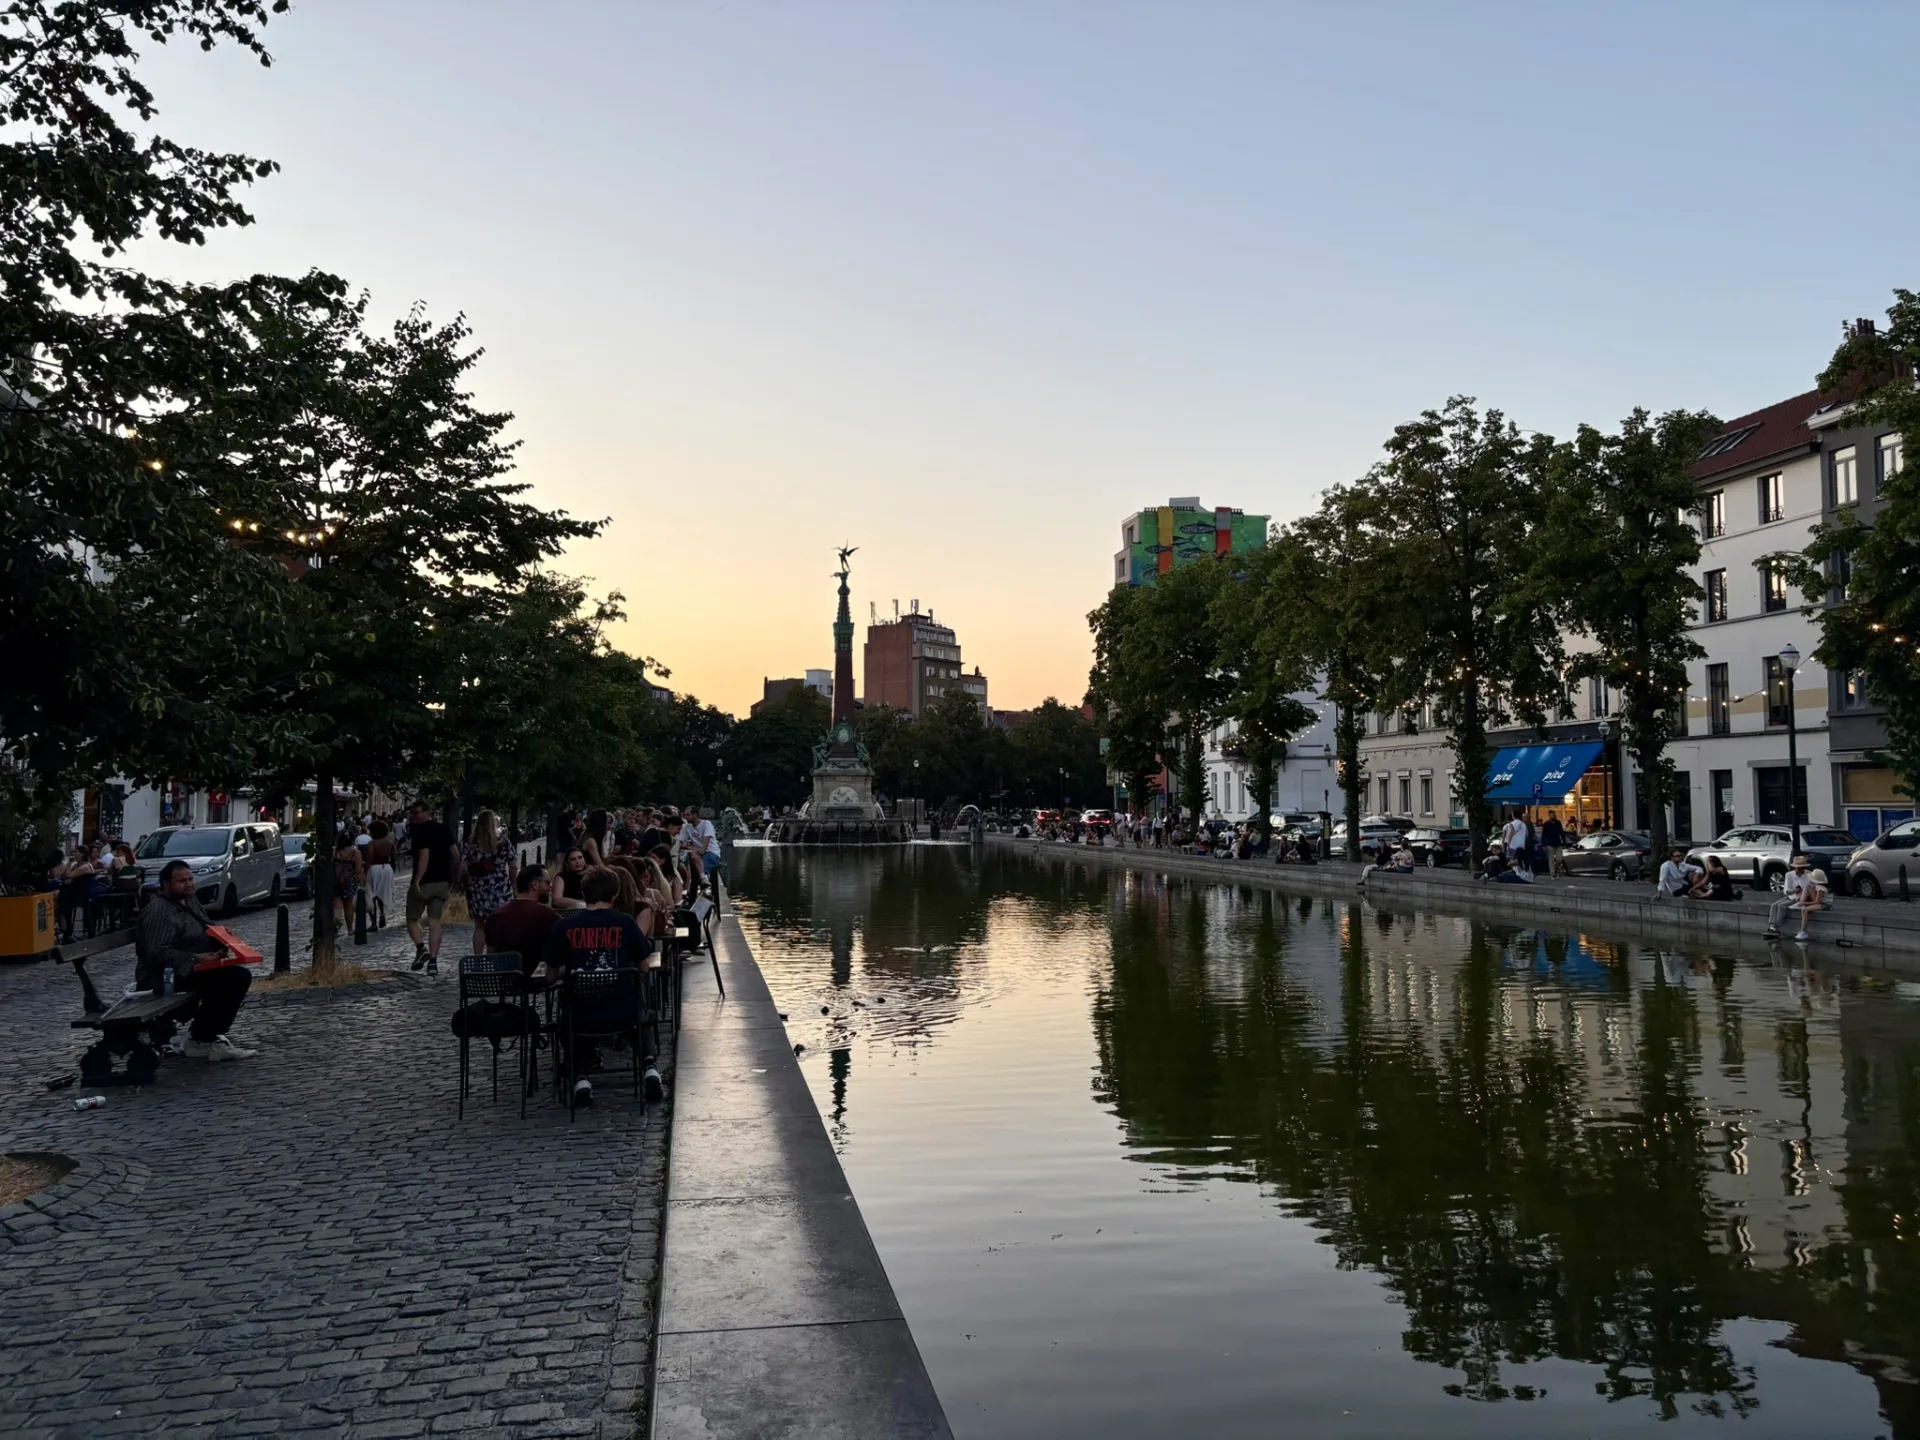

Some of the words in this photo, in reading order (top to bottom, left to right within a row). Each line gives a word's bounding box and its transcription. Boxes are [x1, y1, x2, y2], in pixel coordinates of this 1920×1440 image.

[1492, 772, 1513, 782] pita
[1543, 770, 1565, 781] pita
[567, 927, 622, 948] SCARFACE
